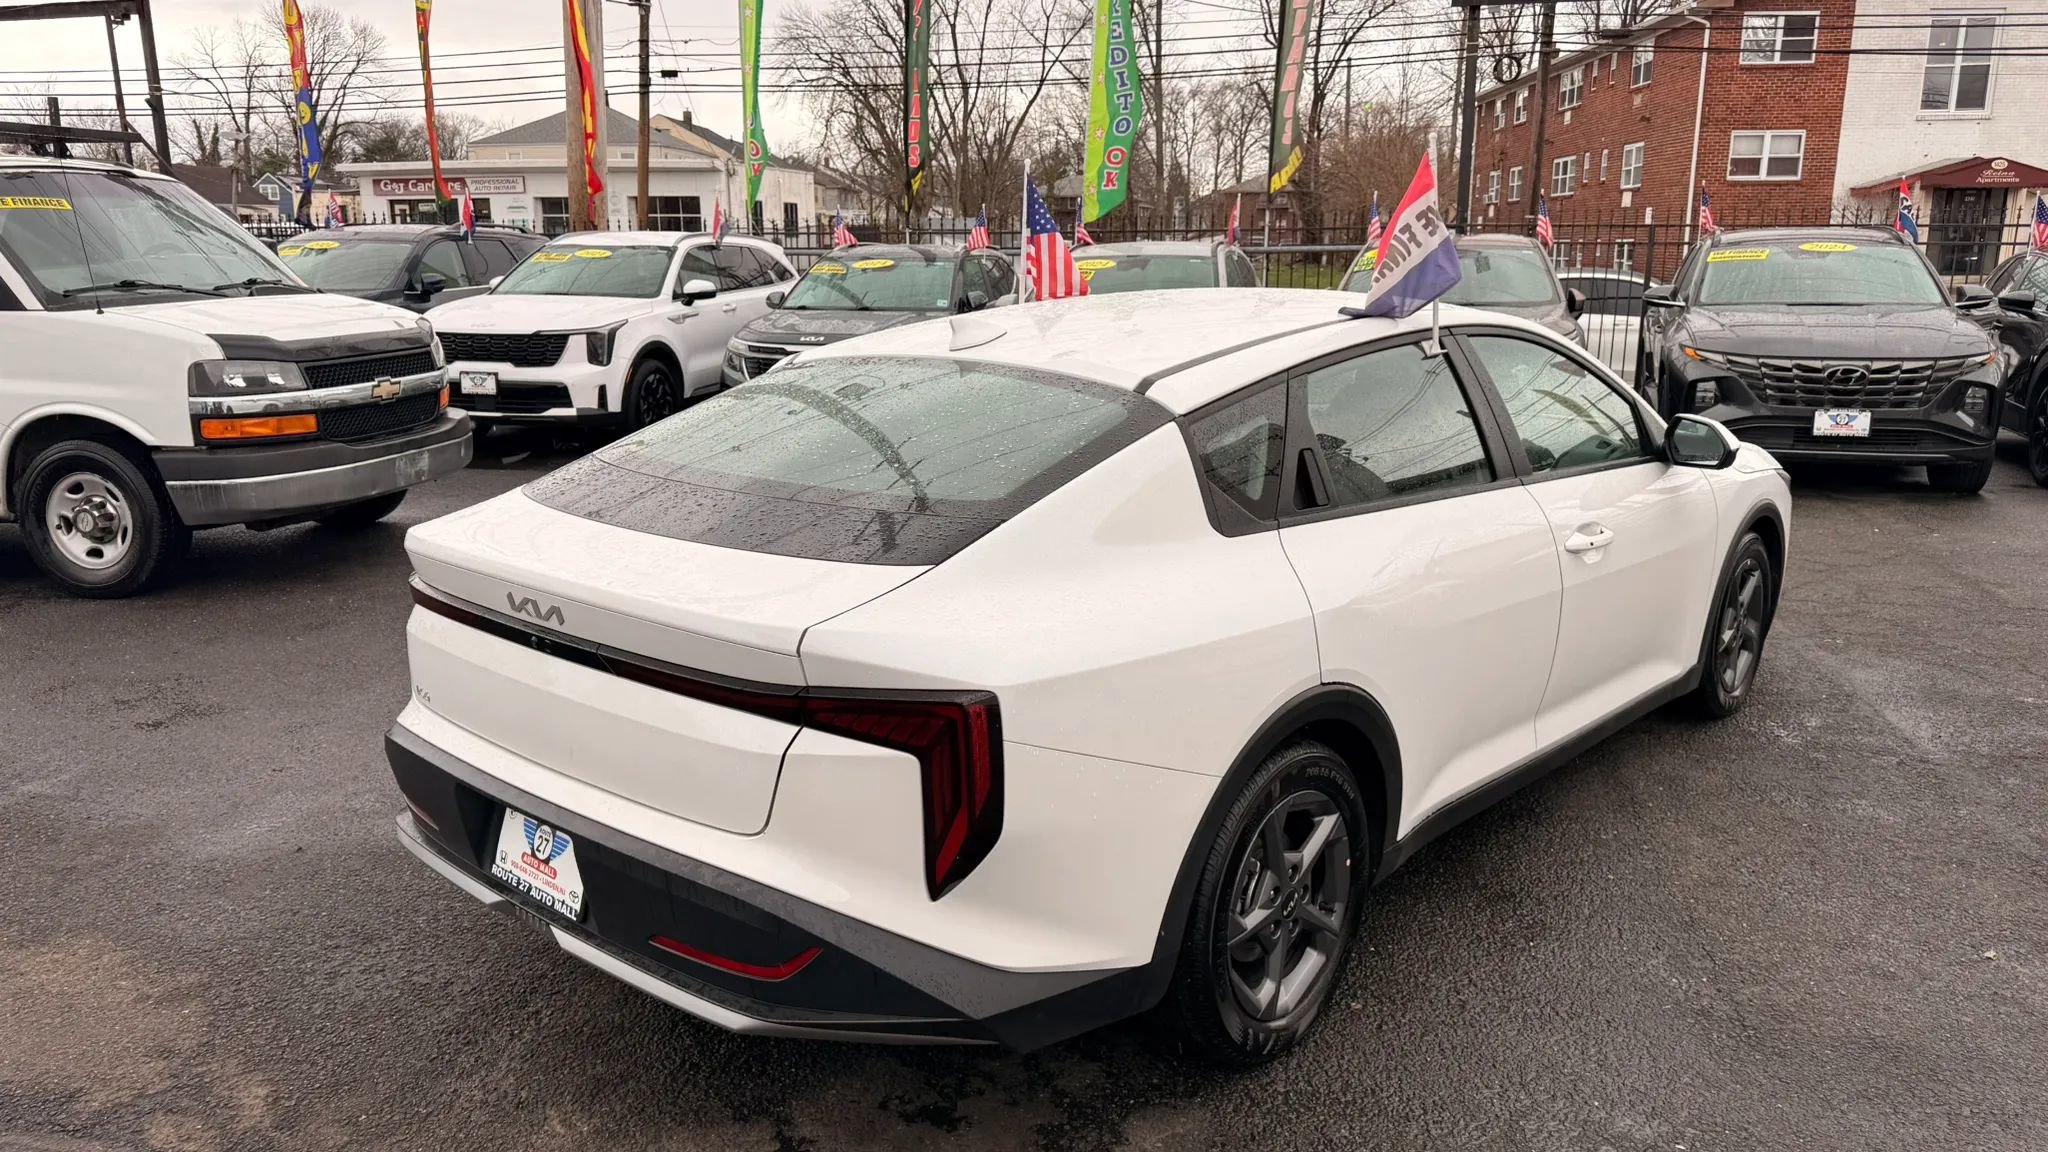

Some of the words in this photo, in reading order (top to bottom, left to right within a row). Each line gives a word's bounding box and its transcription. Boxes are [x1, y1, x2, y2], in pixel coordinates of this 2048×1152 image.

[1102, 146, 1127, 190] OK
[1976, 176, 2020, 184] Apartments
[10, 197, 65, 207] FINANCE
[506, 591, 565, 627] KIA
[535, 835, 550, 856] 27
[523, 854, 539, 869] AUTO
[539, 862, 556, 878] MALL
[491, 863, 518, 886] ROUTE
[518, 879, 530, 893] 27
[530, 886, 554, 906] AUTO
[553, 900, 577, 921] MALL
